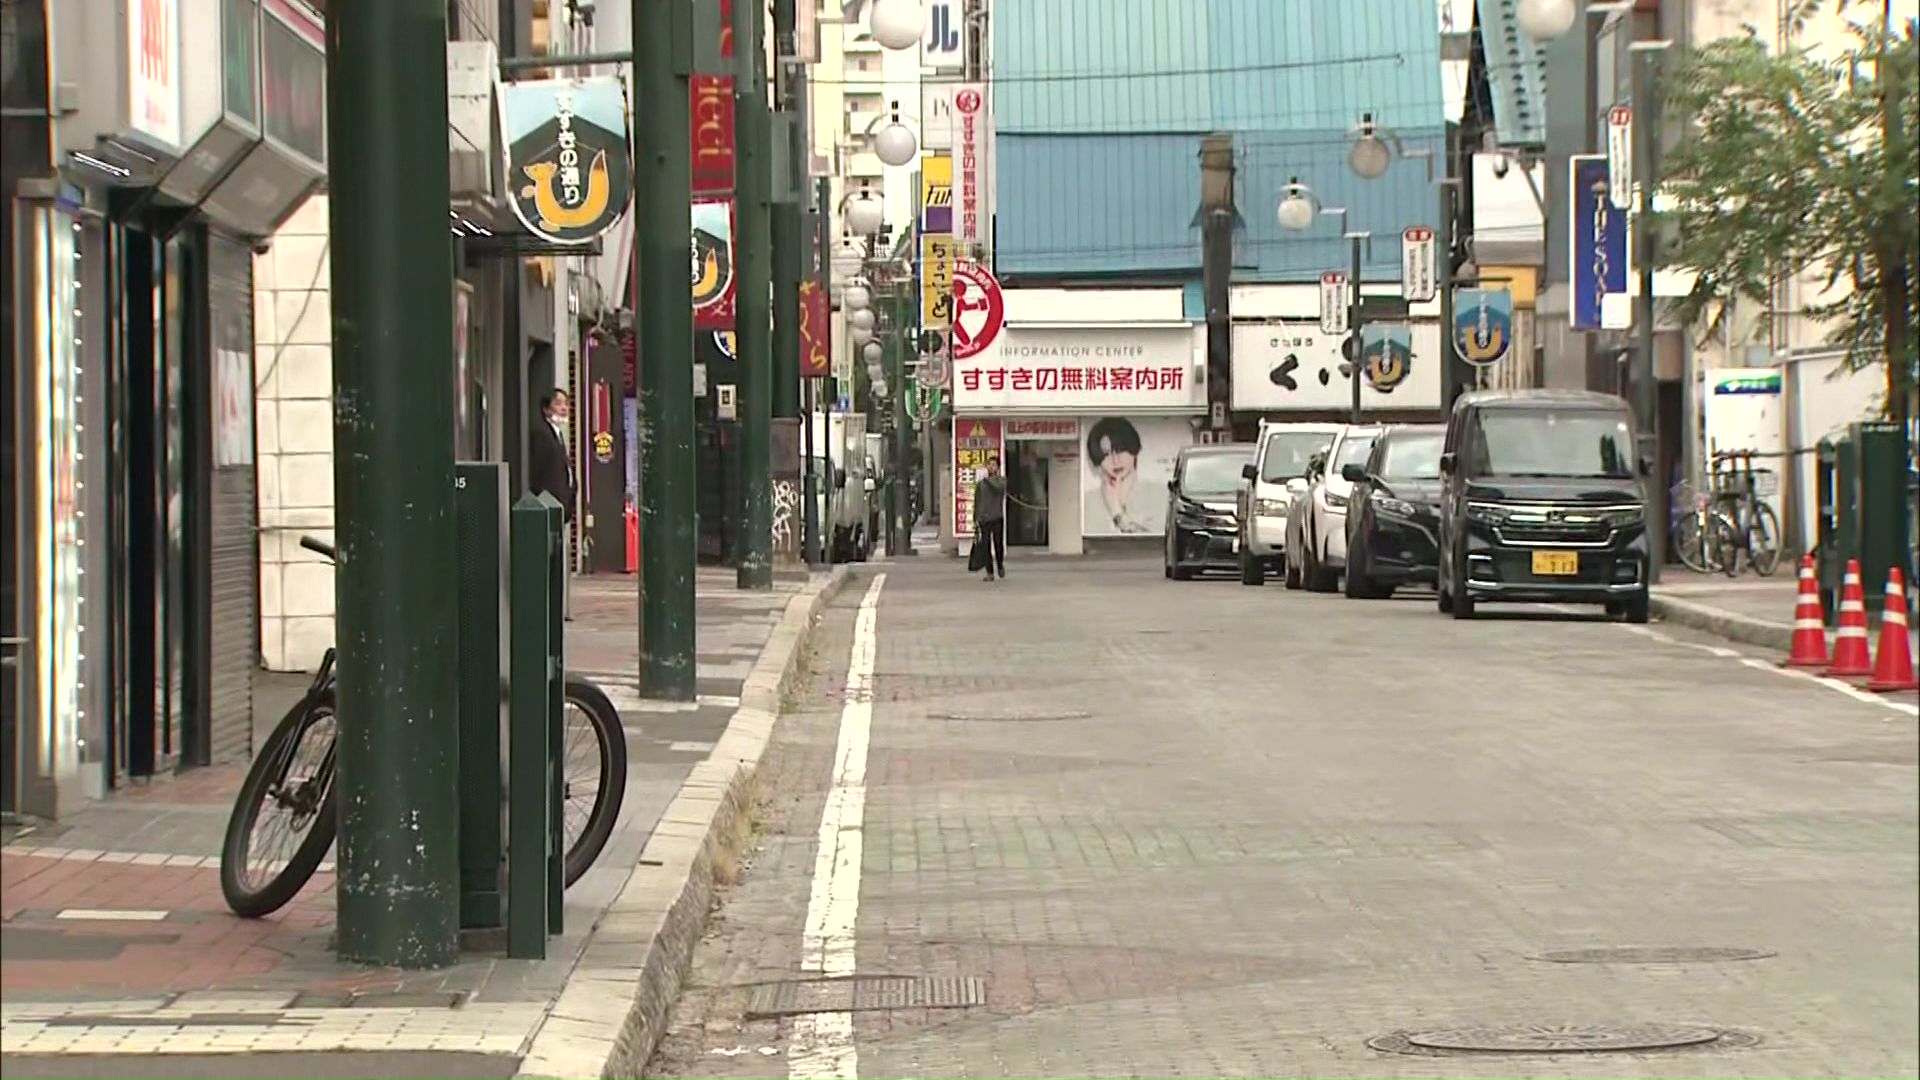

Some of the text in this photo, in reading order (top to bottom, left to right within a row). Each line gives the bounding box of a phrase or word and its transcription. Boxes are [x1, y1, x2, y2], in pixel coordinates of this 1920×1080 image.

[962, 115, 977, 240] すすきの無料案内所
[1000, 346, 1144, 357] INFORMATION CENTER
[961, 367, 1184, 391] すすきの無料案内所
